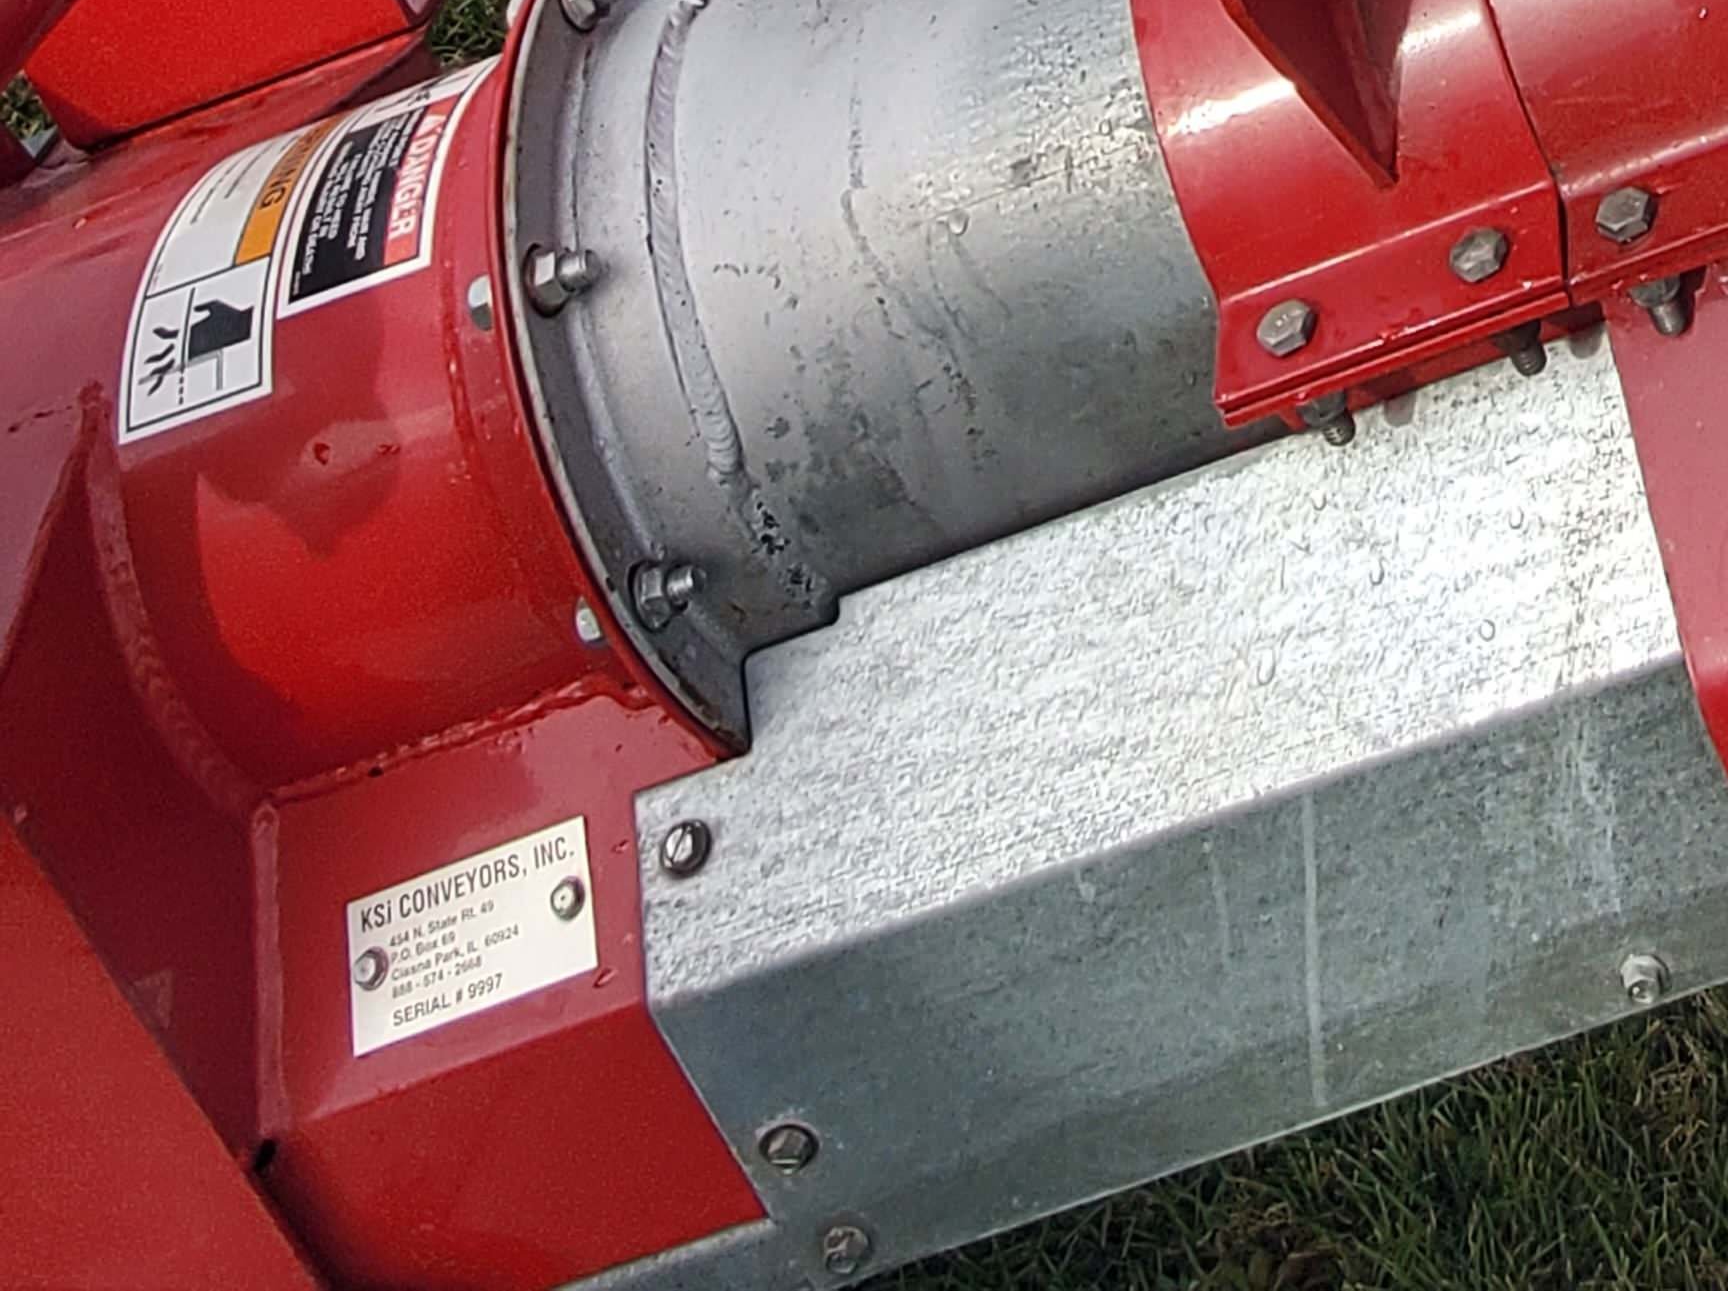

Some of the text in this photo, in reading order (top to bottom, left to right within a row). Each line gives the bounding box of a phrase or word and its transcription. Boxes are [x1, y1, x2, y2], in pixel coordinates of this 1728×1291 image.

[388, 129, 442, 240] DANGER
[399, 854, 526, 918] CONVEYORS,
[533, 837, 574, 869] INC.
[389, 900, 494, 947] 454 N. State Rt. 49
[435, 947, 464, 966] Park,
[467, 940, 477, 954] IL
[484, 925, 518, 946] 60924
[390, 947, 411, 964] P.O.
[415, 940, 437, 955] Box
[393, 973, 502, 1026] SERIAL # 9997
[423, 969, 443, 987] 574
